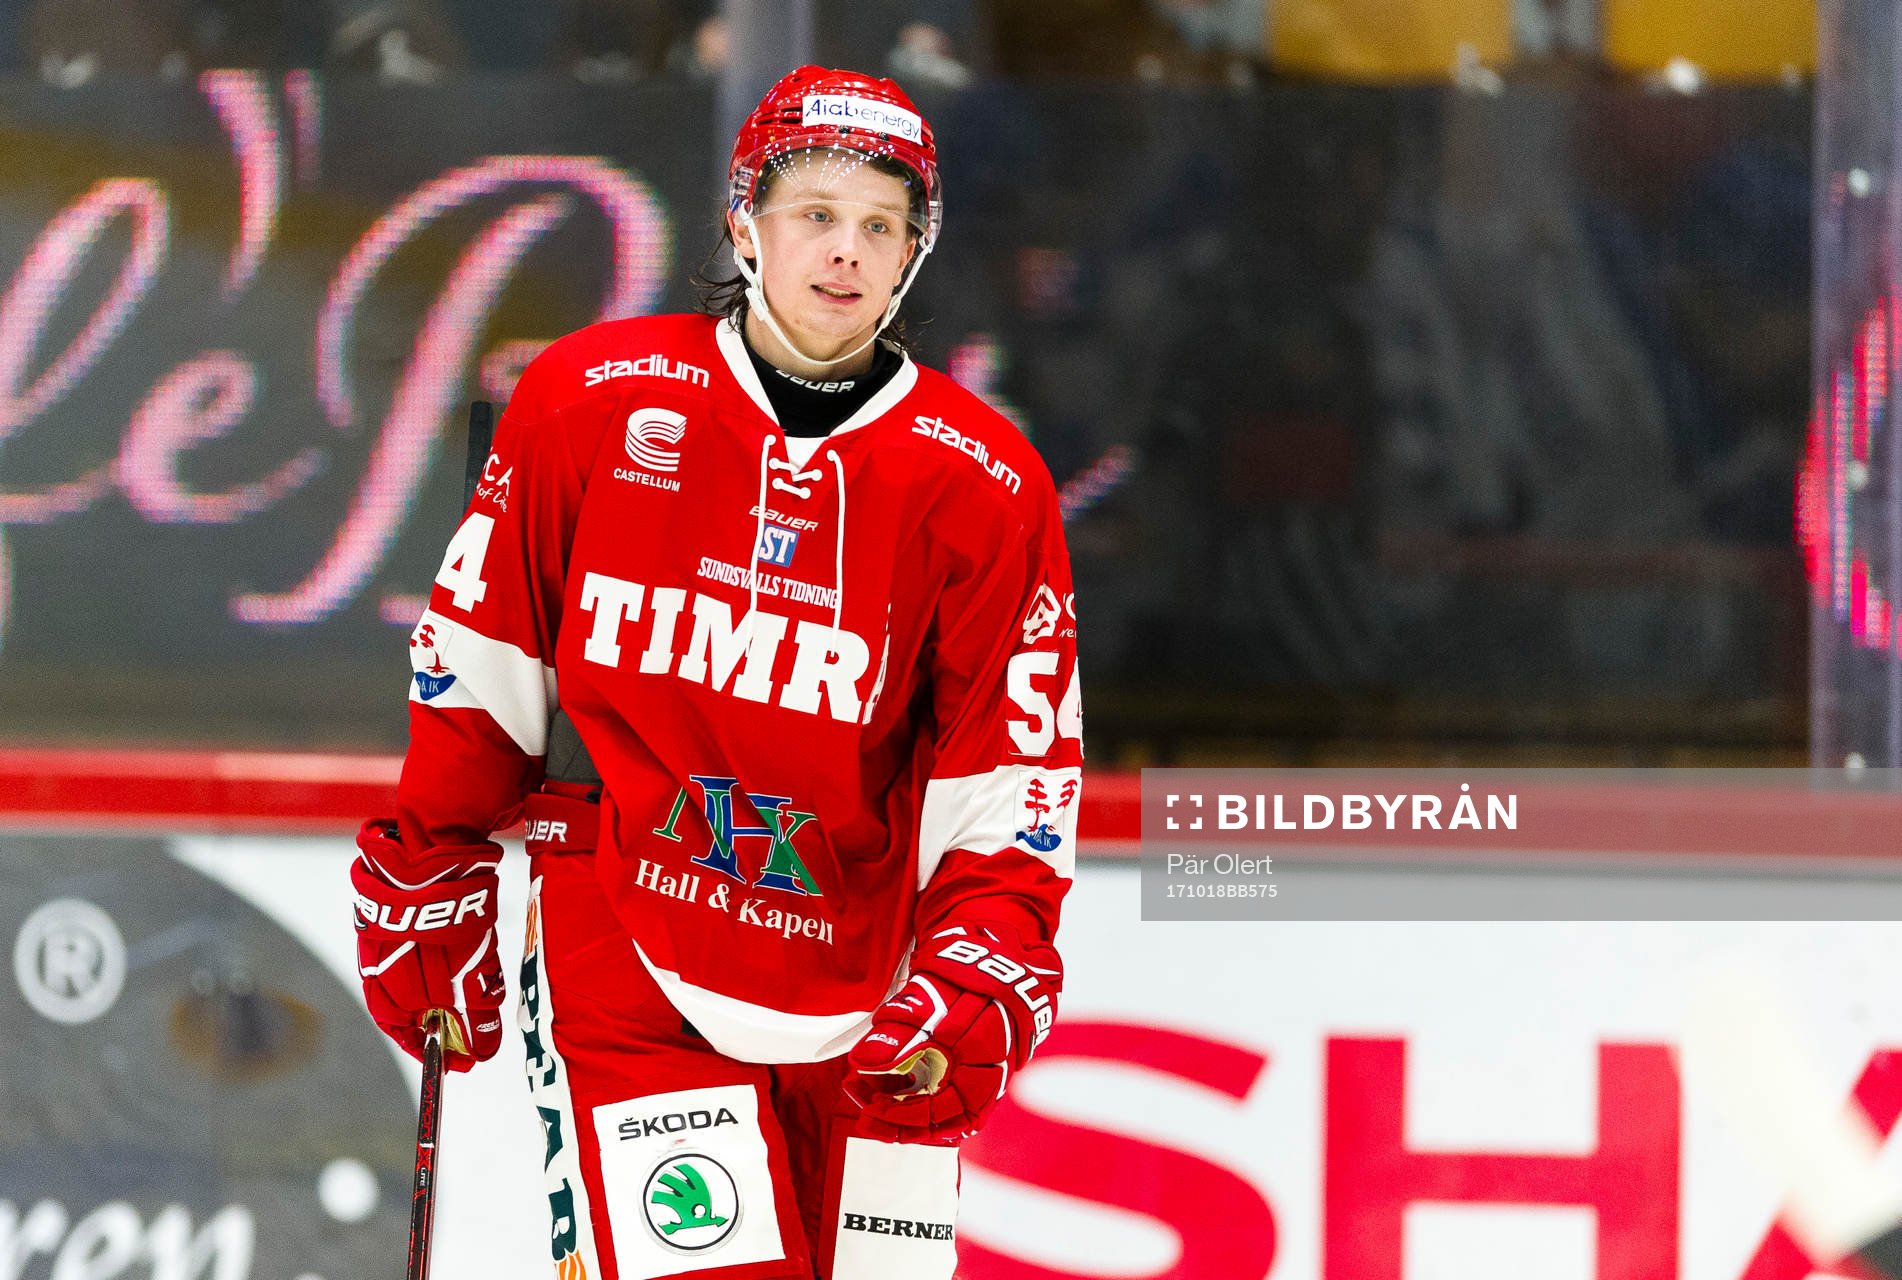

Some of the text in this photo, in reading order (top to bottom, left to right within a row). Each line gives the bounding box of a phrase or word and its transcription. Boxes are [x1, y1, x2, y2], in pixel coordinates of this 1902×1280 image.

[585, 354, 709, 388] stadium
[911, 415, 1022, 494] stadium
[613, 468, 680, 492] CASTELLUM
[759, 526, 796, 564] ST
[782, 578, 838, 609] TIDNING
[634, 858, 700, 904] Hall
[707, 883, 730, 913] &
[618, 1107, 739, 1141] ŠKODA
[843, 1212, 954, 1241] BERNER
